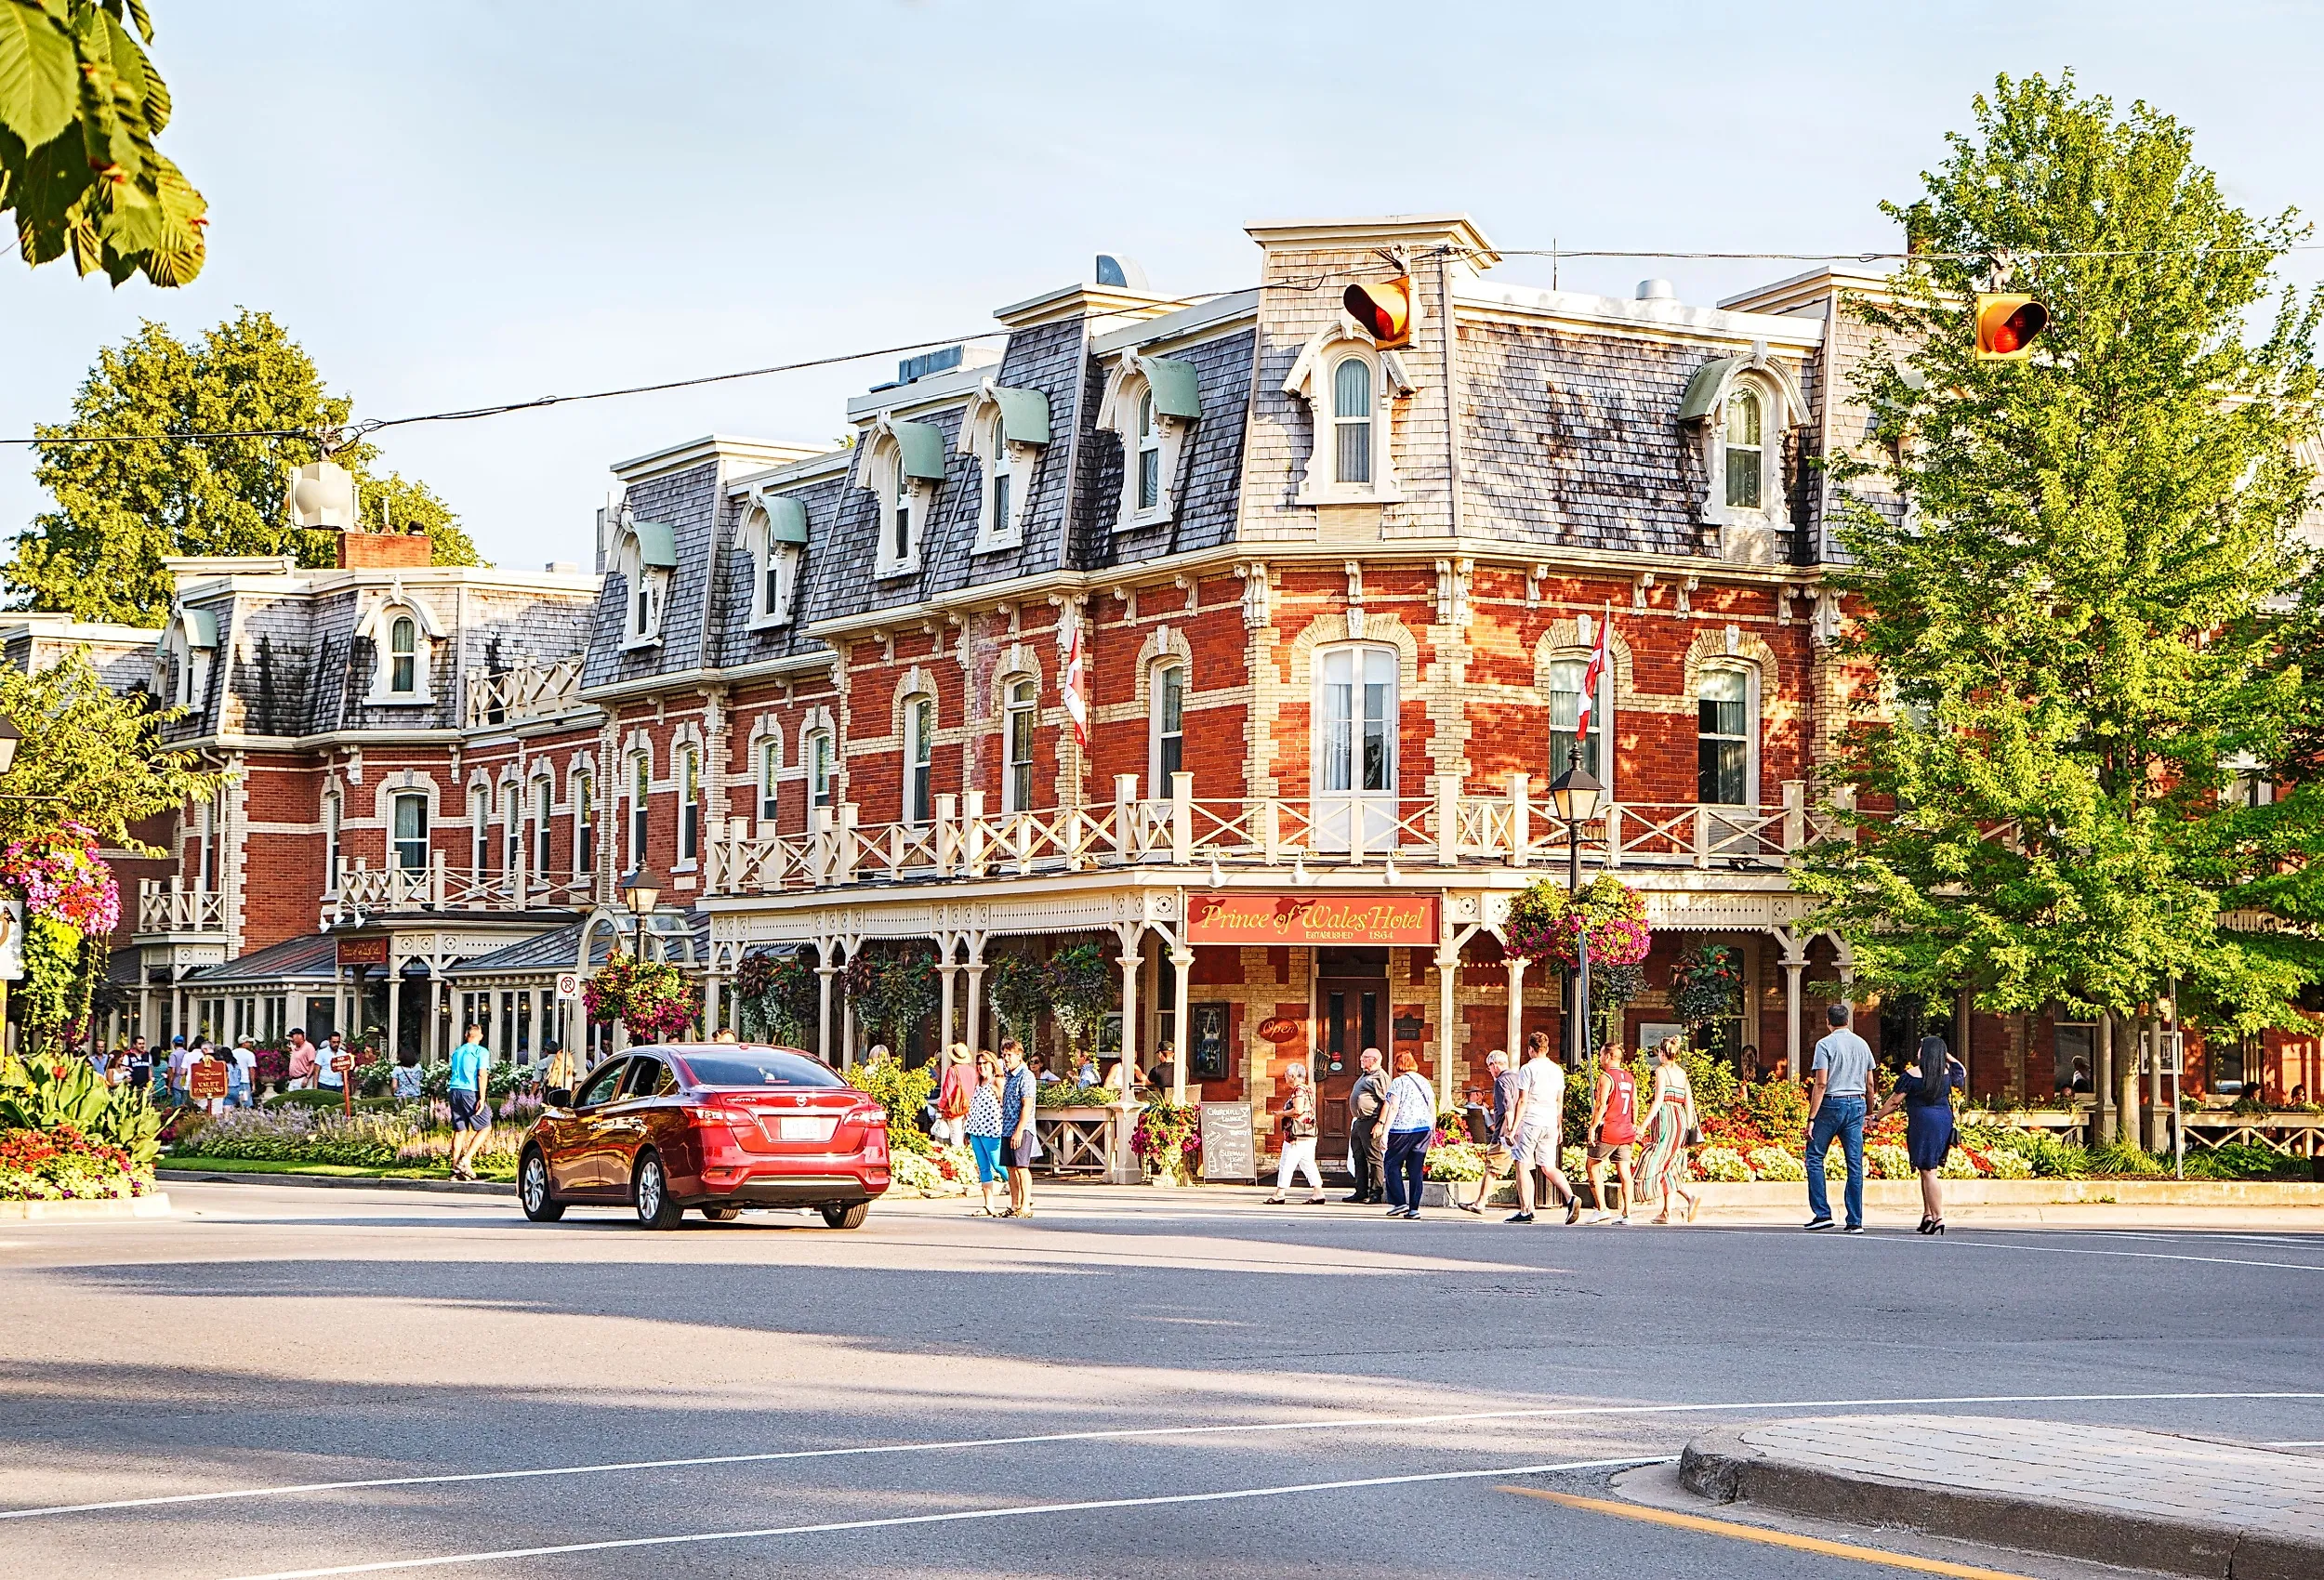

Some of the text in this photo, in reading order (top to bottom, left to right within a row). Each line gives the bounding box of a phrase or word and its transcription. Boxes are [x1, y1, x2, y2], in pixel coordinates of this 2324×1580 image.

[1201, 904, 1426, 935] Prince of Wales Hotel
[1305, 931, 1393, 940] ESTABLISHED 1864
[1262, 1020, 1295, 1038] Open
[1620, 1091, 1631, 1116] 7
